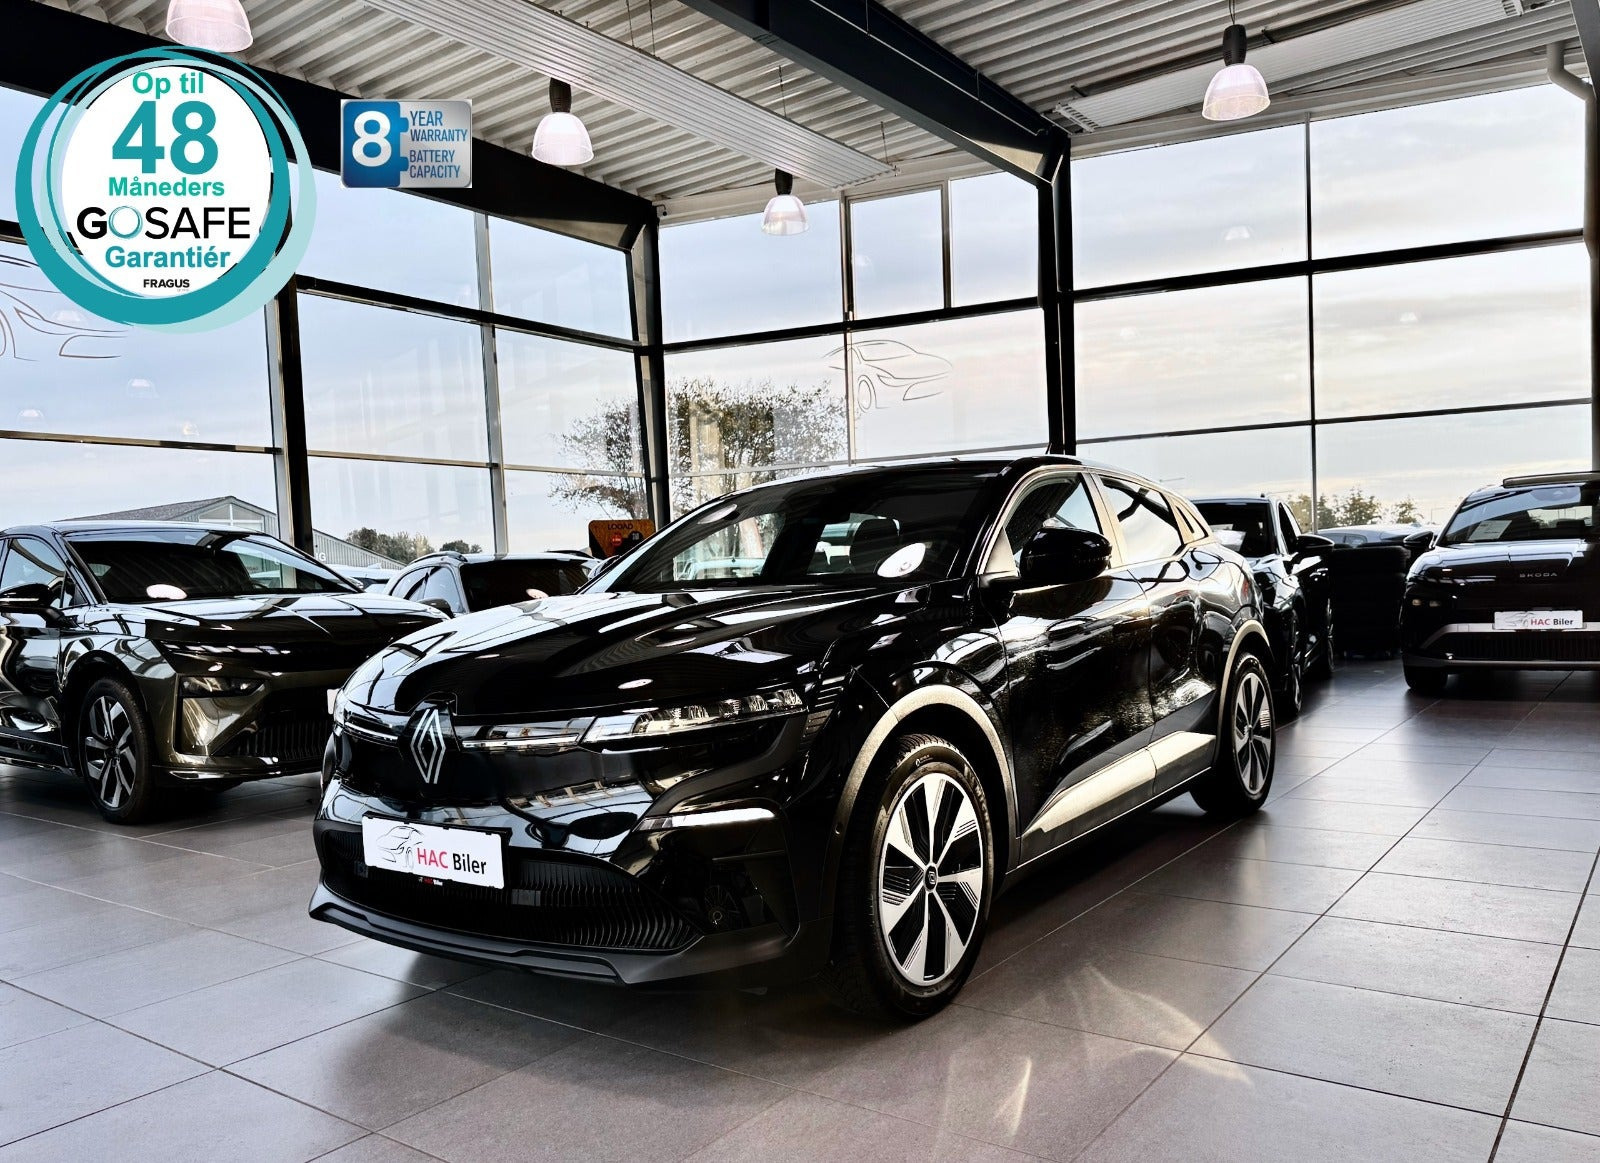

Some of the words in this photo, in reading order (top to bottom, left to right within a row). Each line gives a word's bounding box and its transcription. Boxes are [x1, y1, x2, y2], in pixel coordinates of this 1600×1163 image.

[1530, 618, 1551, 626] HAC
[1553, 618, 1574, 626] Biler
[417, 847, 449, 869] HAC
[452, 853, 487, 875] Biler
